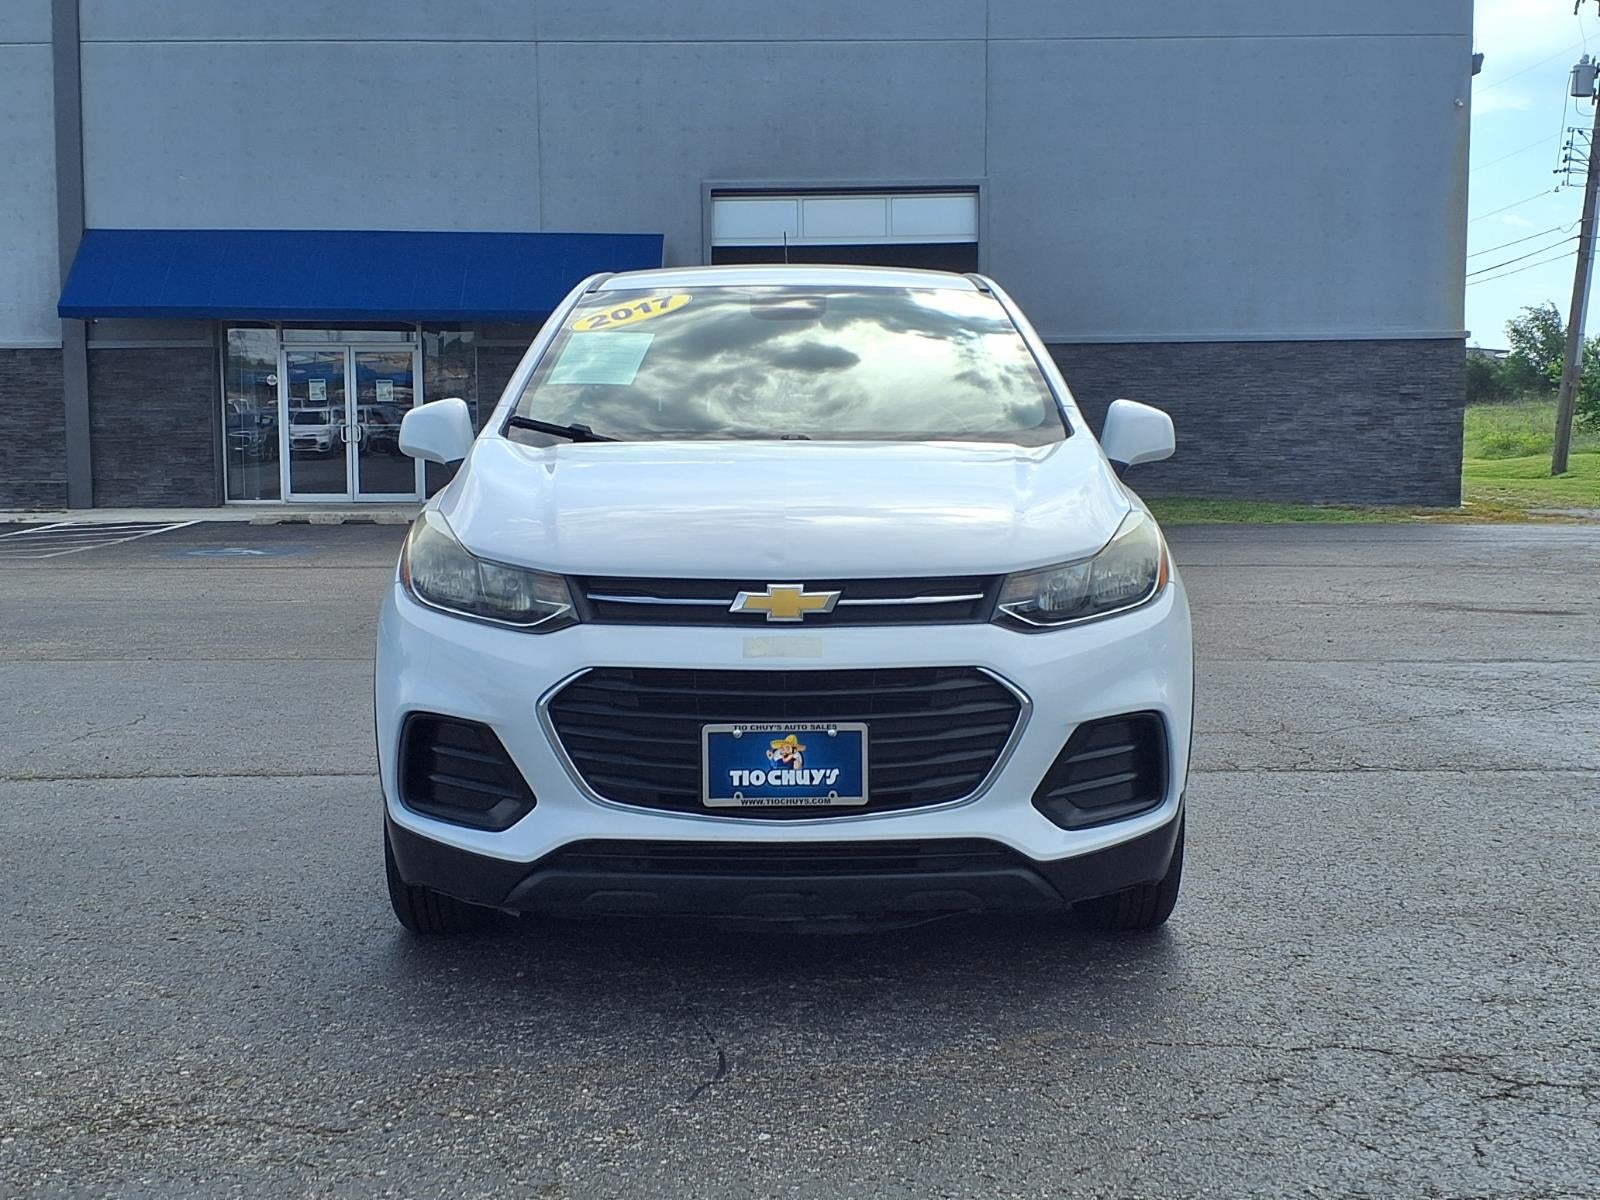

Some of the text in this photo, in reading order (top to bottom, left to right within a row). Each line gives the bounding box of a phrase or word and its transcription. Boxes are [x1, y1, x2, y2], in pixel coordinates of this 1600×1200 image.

[587, 296, 672, 329] 2017
[810, 723, 837, 731] SALES
[741, 798, 831, 806] WWW.TIOCHUYS.COM
